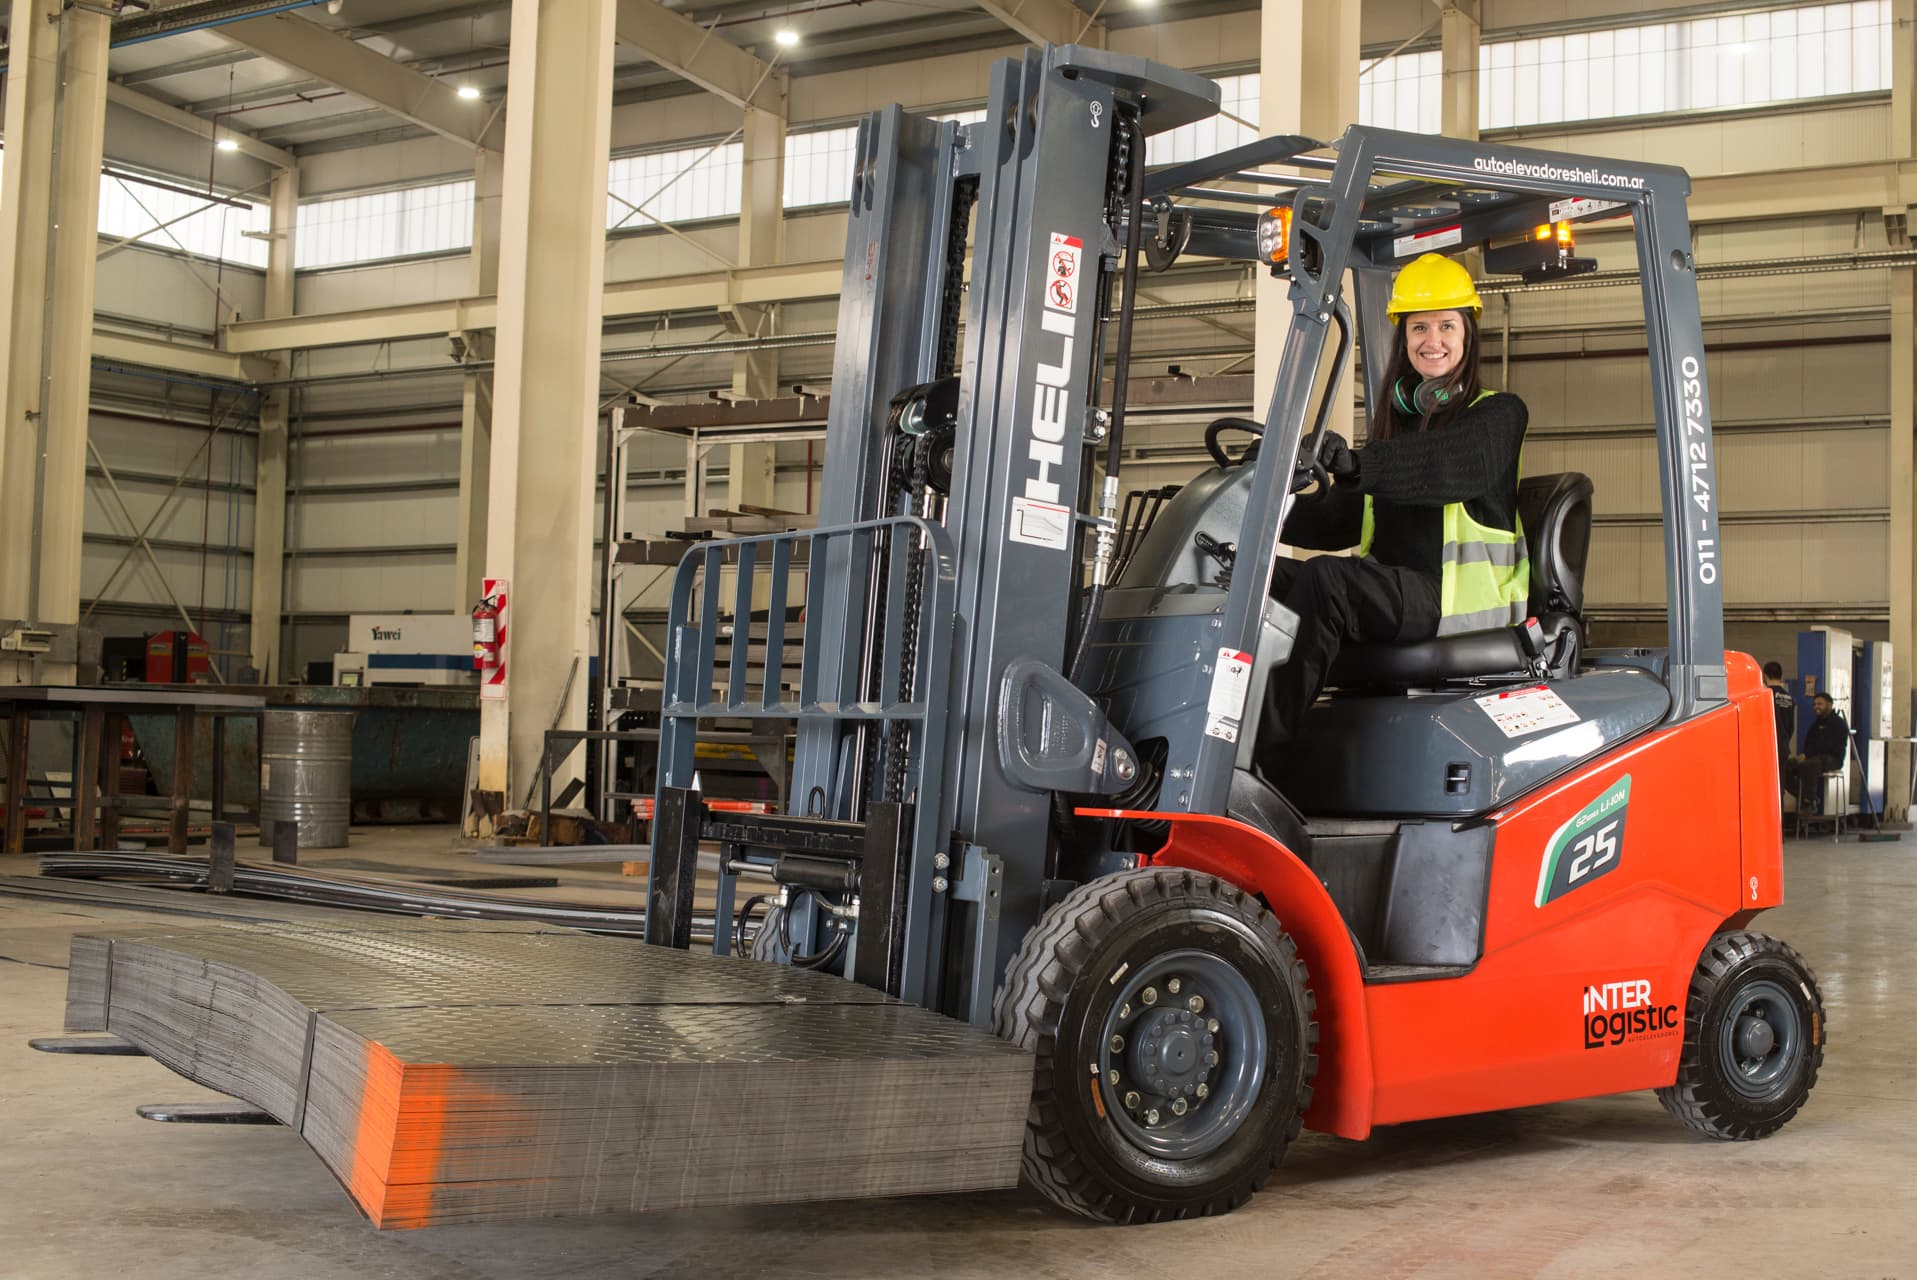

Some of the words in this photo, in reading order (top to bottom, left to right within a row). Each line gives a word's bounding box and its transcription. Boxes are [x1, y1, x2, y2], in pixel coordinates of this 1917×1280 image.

[1474, 155, 1645, 190] autoelevadoresheli.com.ar
[1024, 310, 1076, 504] HELI
[1681, 356, 1705, 436] 7330
[1690, 442, 1711, 513] 4712
[1696, 538, 1717, 585] 011
[371, 626, 401, 641] Yawei
[1568, 819, 1619, 884] 25
[1584, 1004, 1678, 1050] Logistic
